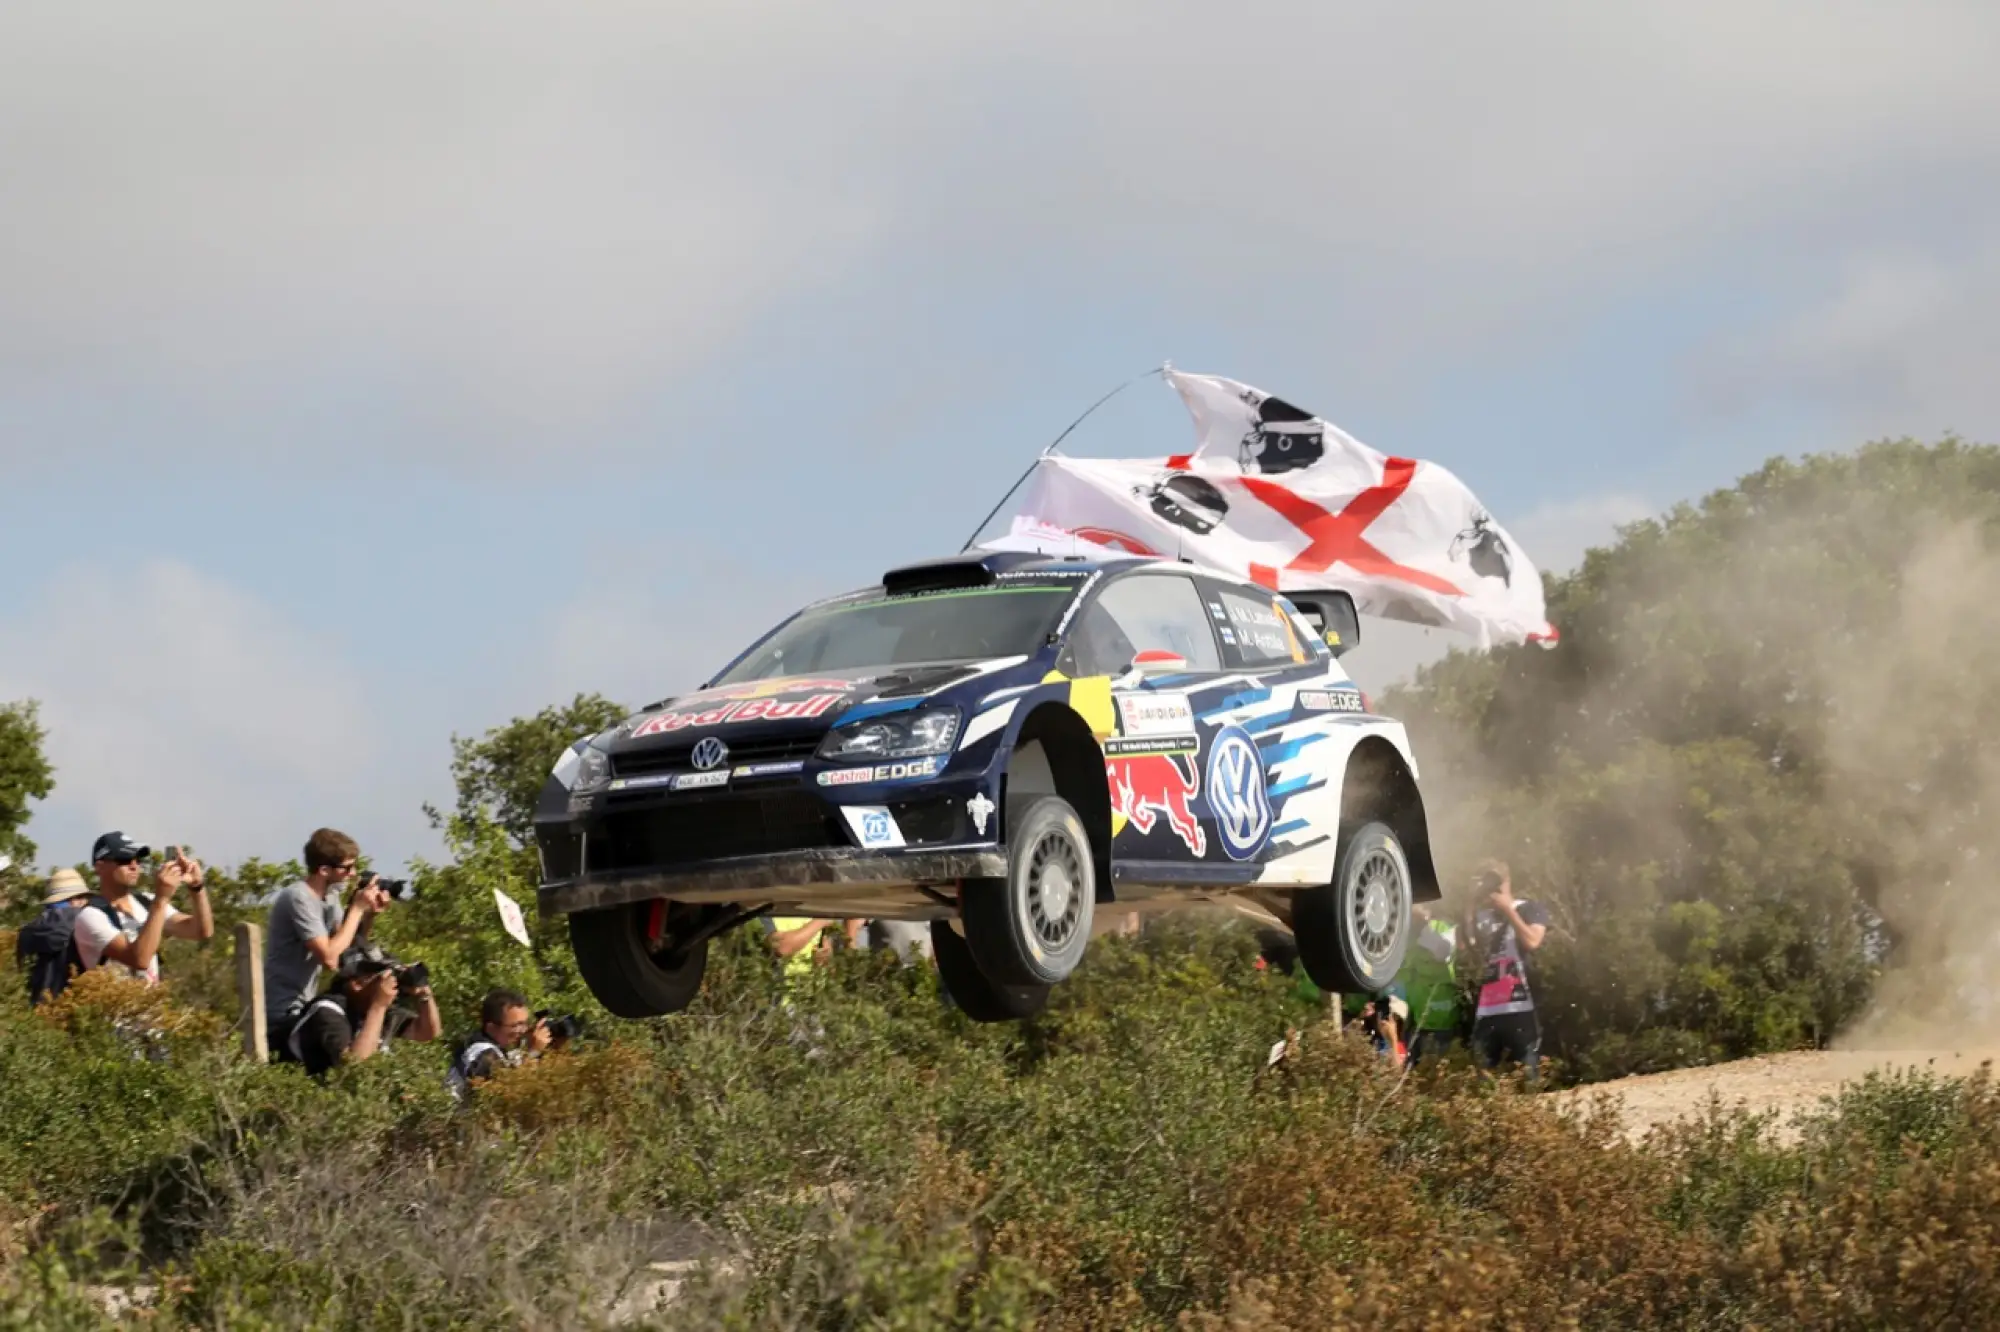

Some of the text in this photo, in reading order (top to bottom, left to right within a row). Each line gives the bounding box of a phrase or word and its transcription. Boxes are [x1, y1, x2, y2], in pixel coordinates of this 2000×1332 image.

[1330, 692, 1364, 711] EDGE
[631, 693, 847, 738] Red Bull
[829, 759, 937, 784] Castrol EDGE
